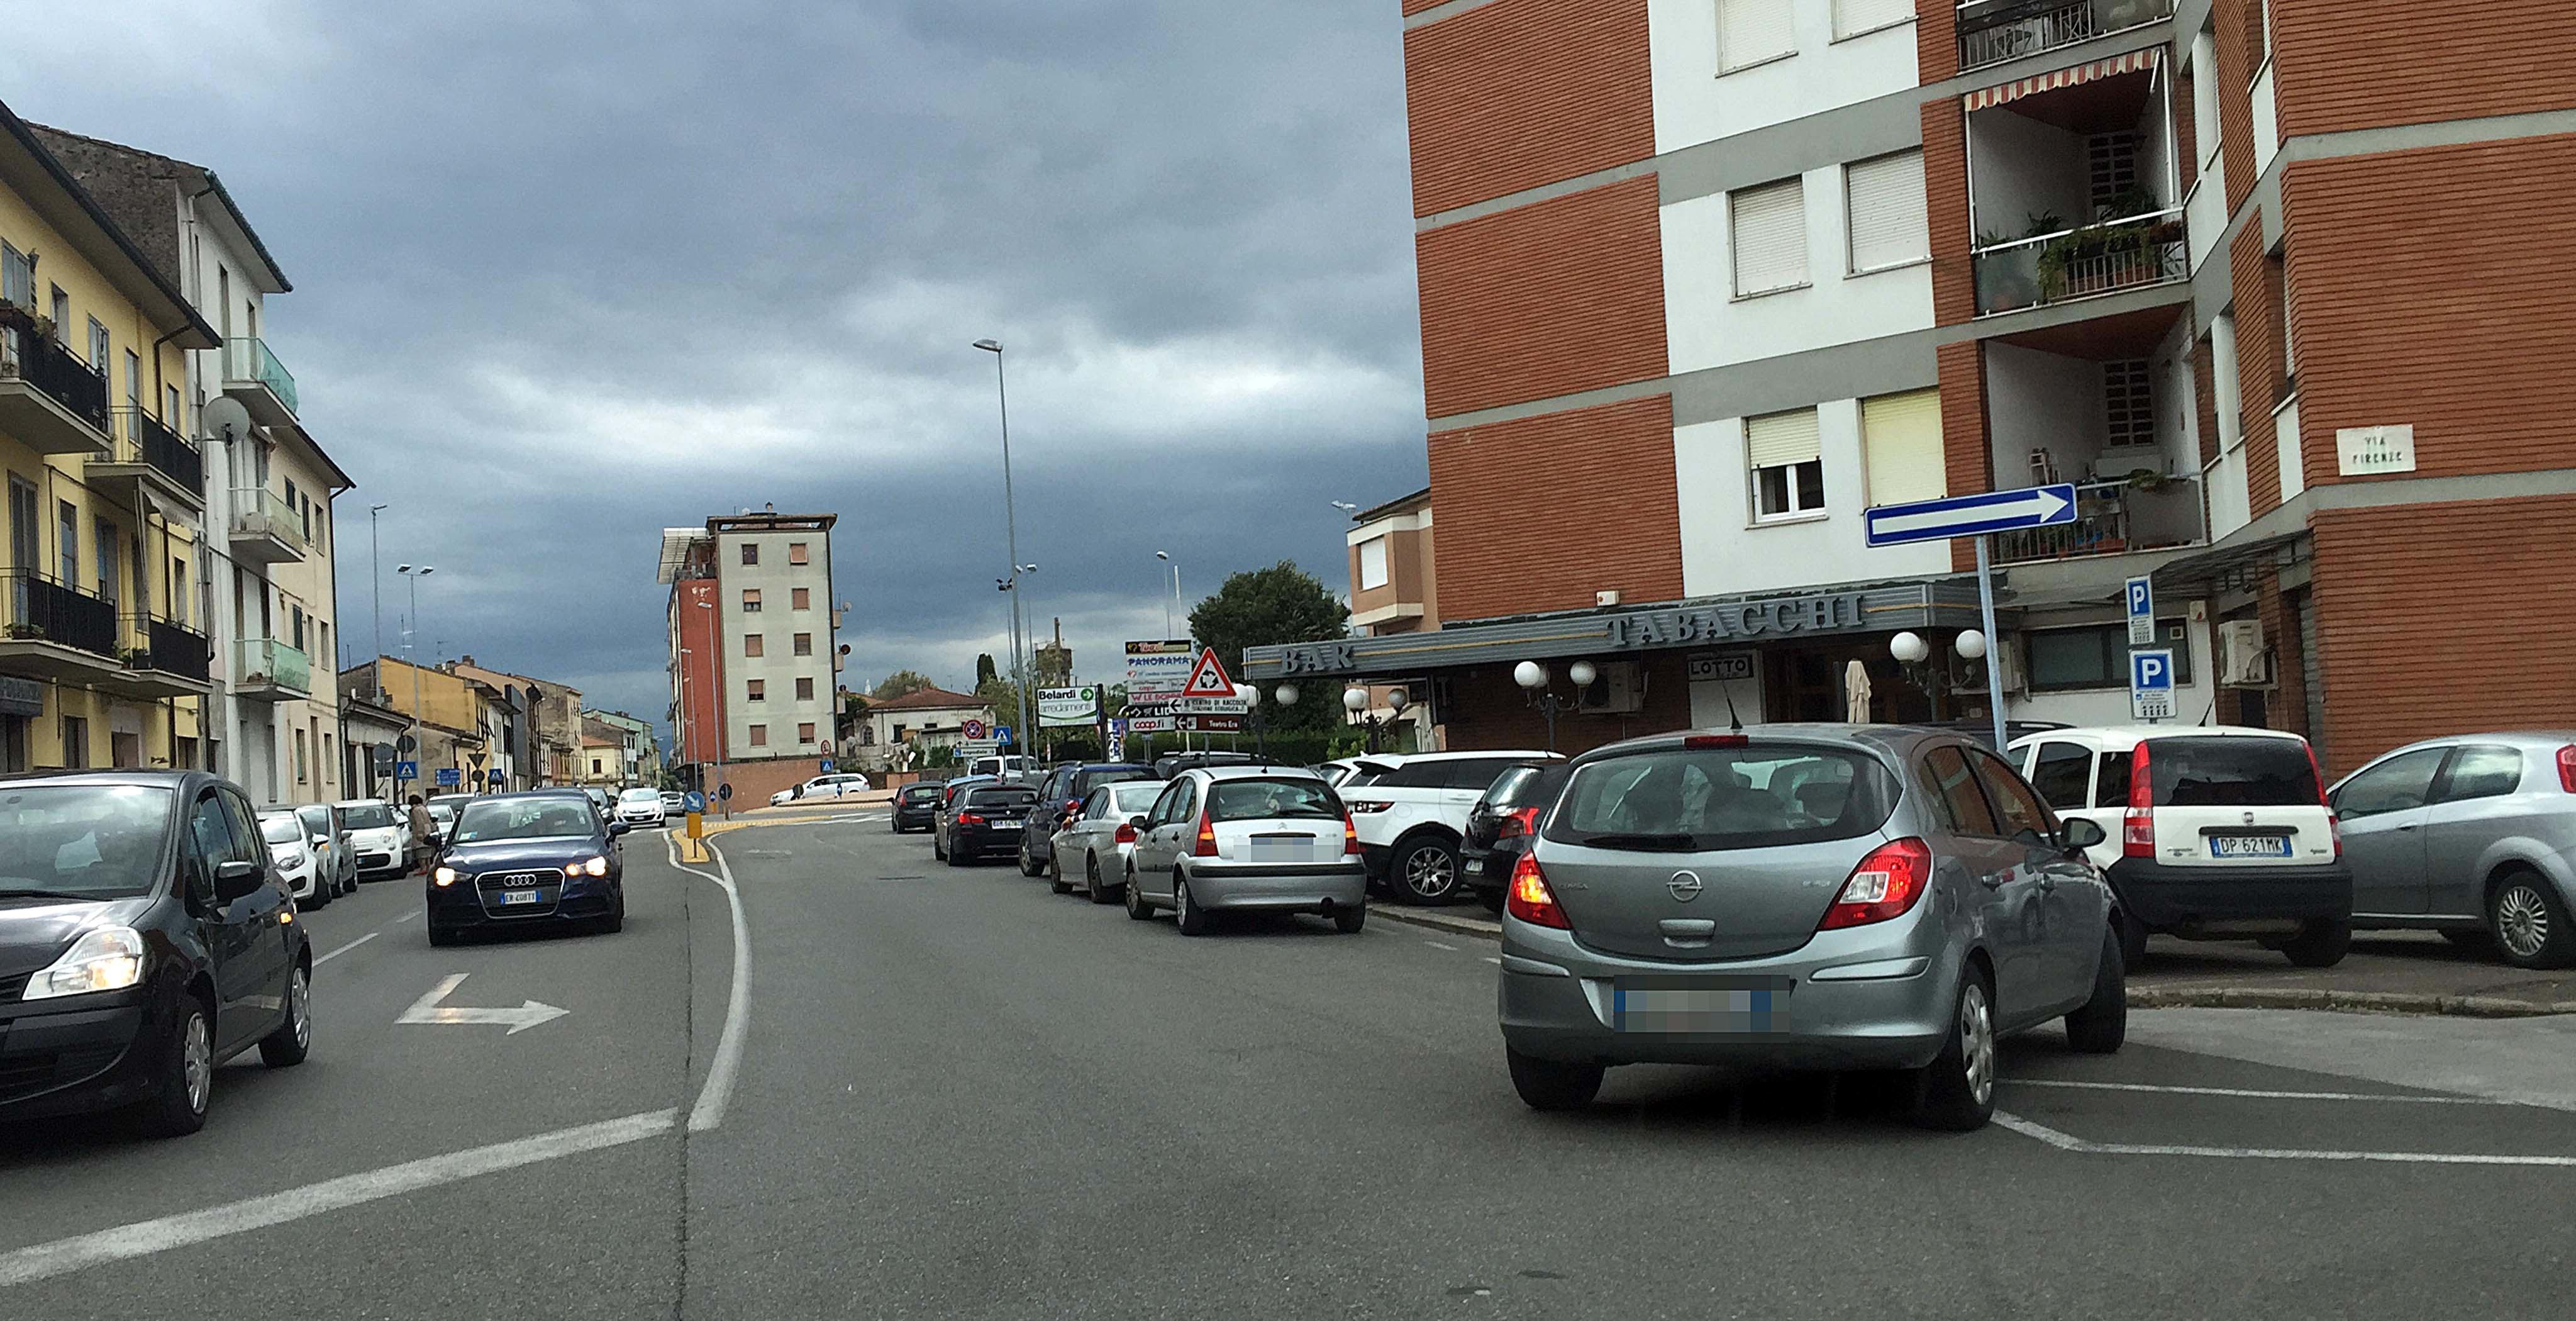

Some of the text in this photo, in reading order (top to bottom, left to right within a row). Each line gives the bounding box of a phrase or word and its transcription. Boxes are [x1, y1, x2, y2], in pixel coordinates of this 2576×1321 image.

[2365, 437, 2385, 445] VIA
[2353, 451, 2402, 464] FIRENZE
[2133, 586, 2145, 611] P
[1606, 594, 1864, 646] TABACCHI
[1128, 656, 1189, 666] PANORAMA
[1280, 644, 1353, 673] BAR
[1691, 659, 1746, 674] LOTTO
[2141, 659, 2162, 686] P
[1039, 689, 1076, 700] Belardi
[1155, 706, 1170, 716] LID
[2220, 837, 2282, 854] DP 621MK
